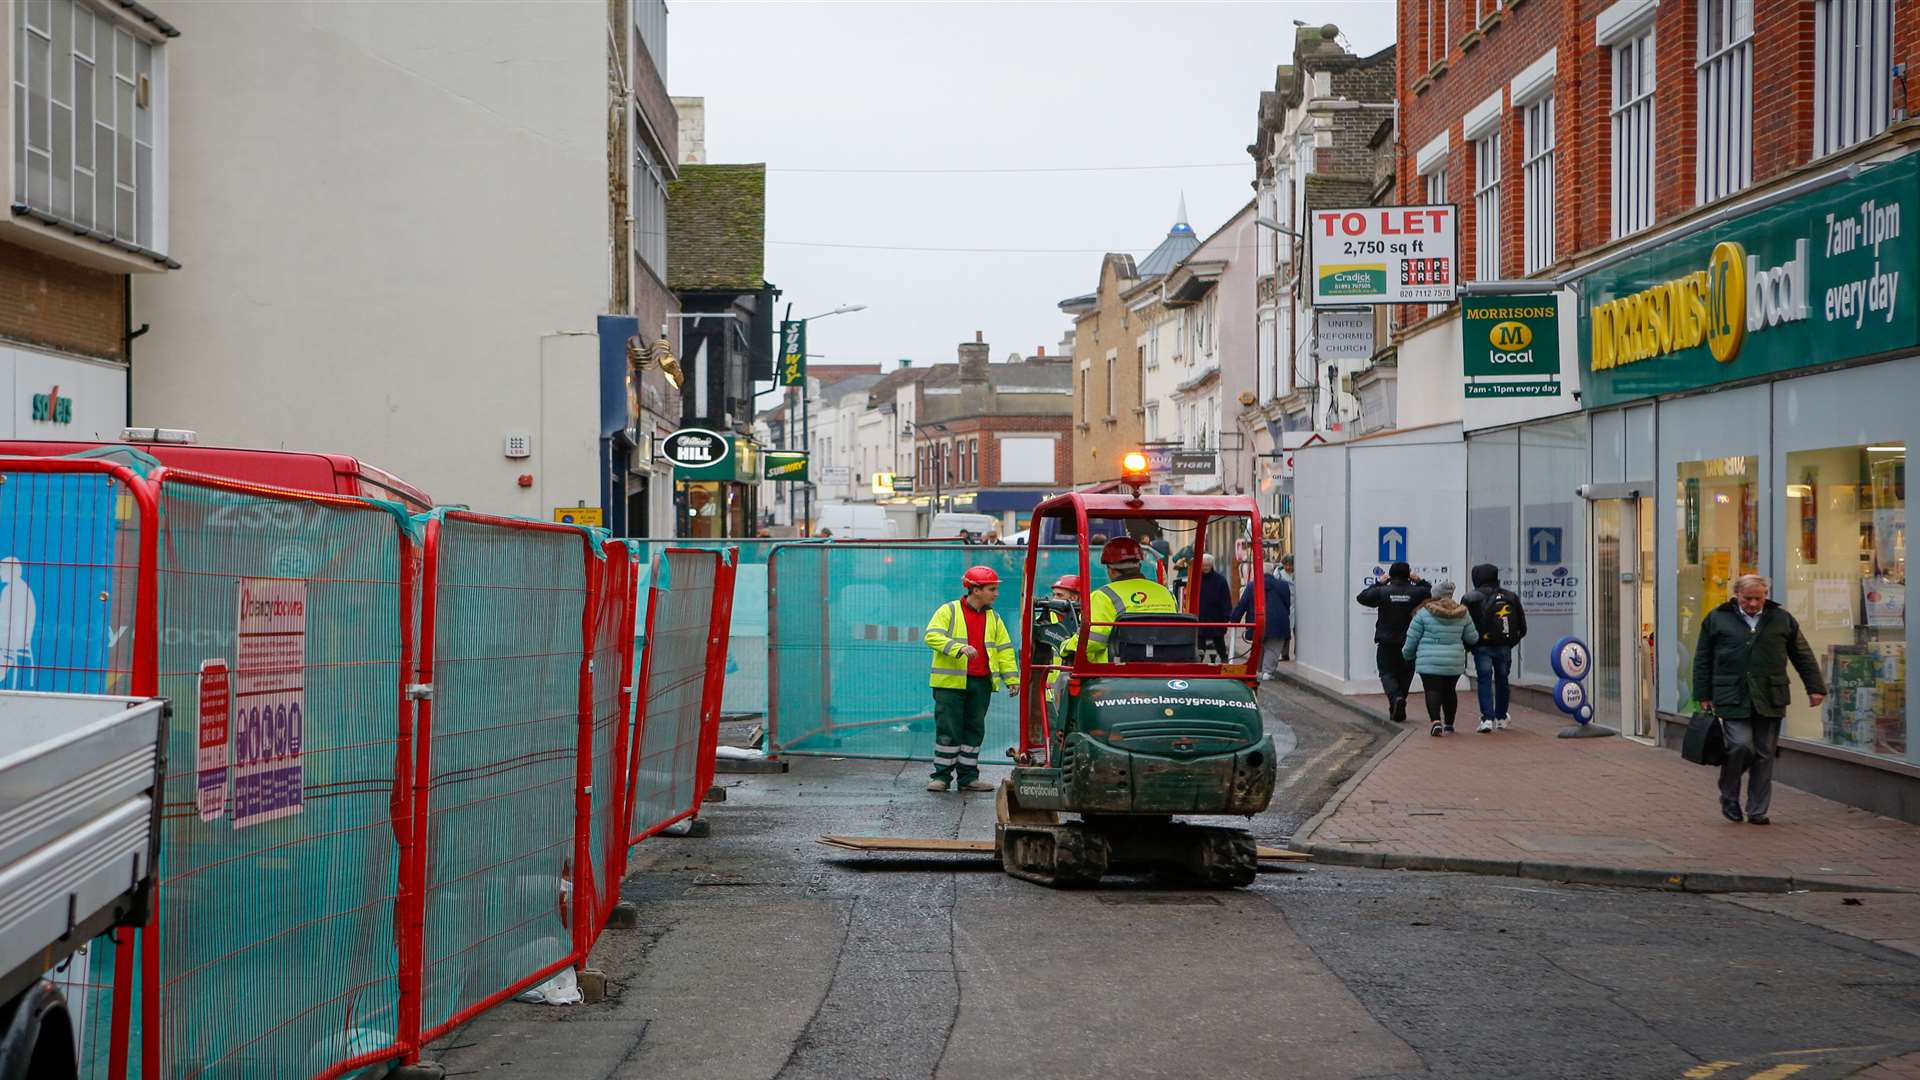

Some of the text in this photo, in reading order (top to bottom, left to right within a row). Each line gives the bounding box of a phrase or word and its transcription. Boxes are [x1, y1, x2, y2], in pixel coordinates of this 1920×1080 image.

[1319, 210, 1449, 237] TO LET
[1826, 200, 1899, 258] 7am-11pm
[1344, 240, 1424, 256] 2,750 sq ft
[1402, 261, 1449, 271] STRIPE
[1334, 272, 1371, 282] Cradick
[1402, 272, 1449, 281] STREET
[1747, 239, 1811, 332] local
[1415, 289, 1432, 298] 7112
[1825, 261, 1899, 330] every day
[1466, 307, 1554, 320] MORRISONS
[1328, 320, 1363, 328] UNITED
[1319, 332, 1373, 340] REFORMED
[1499, 326, 1524, 345] M
[785, 323, 801, 384] SUBWAY
[1326, 345, 1367, 353] CHURCH
[1490, 349, 1533, 363] local
[1468, 385, 1487, 393] 7am
[1493, 385, 1514, 394] 11pm
[1516, 385, 1540, 394] every
[1541, 383, 1558, 393] day
[677, 447, 712, 460] HILL
[768, 460, 807, 478] SUBWAY
[1176, 462, 1211, 470] TIGER
[1095, 695, 1257, 710] www.theclancygroup.co.uk
